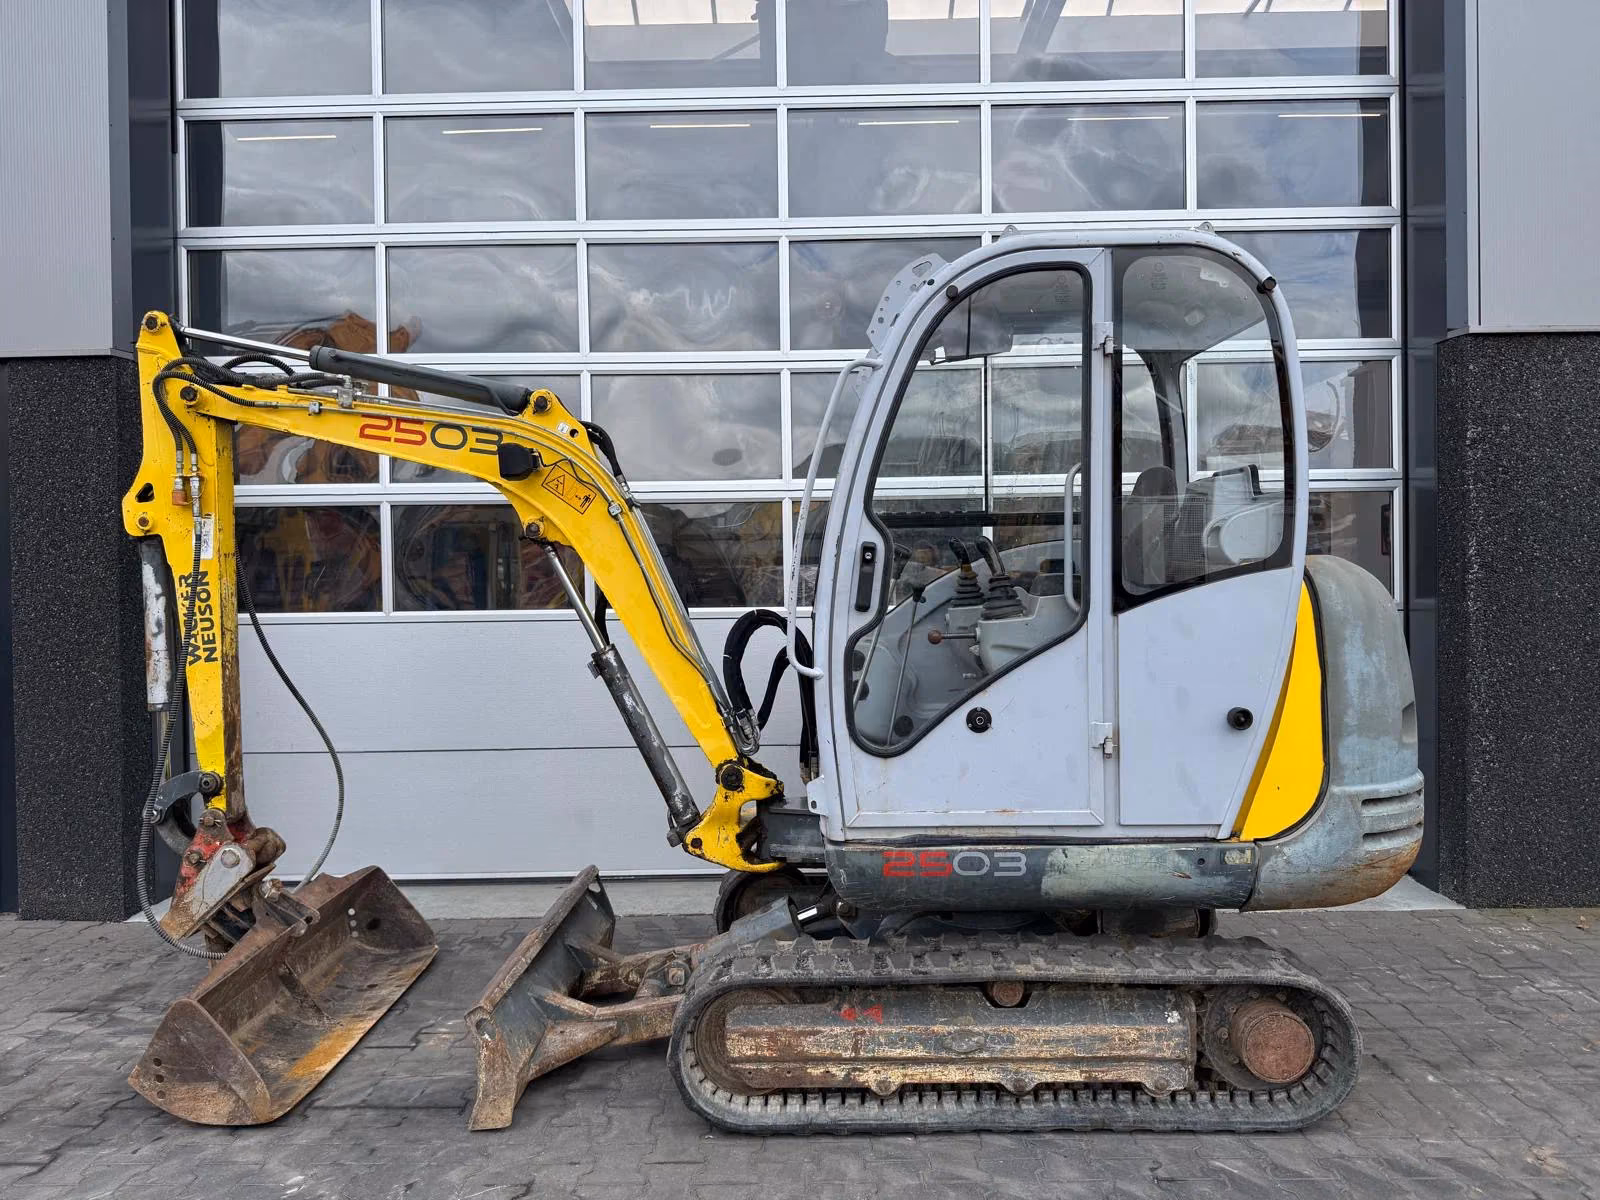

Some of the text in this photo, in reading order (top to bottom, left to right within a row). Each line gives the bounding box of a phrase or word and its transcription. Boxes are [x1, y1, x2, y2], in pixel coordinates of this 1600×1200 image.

[359, 414, 503, 456] 2503
[196, 569, 219, 663] NEUSON
[882, 851, 1027, 877] 2503
